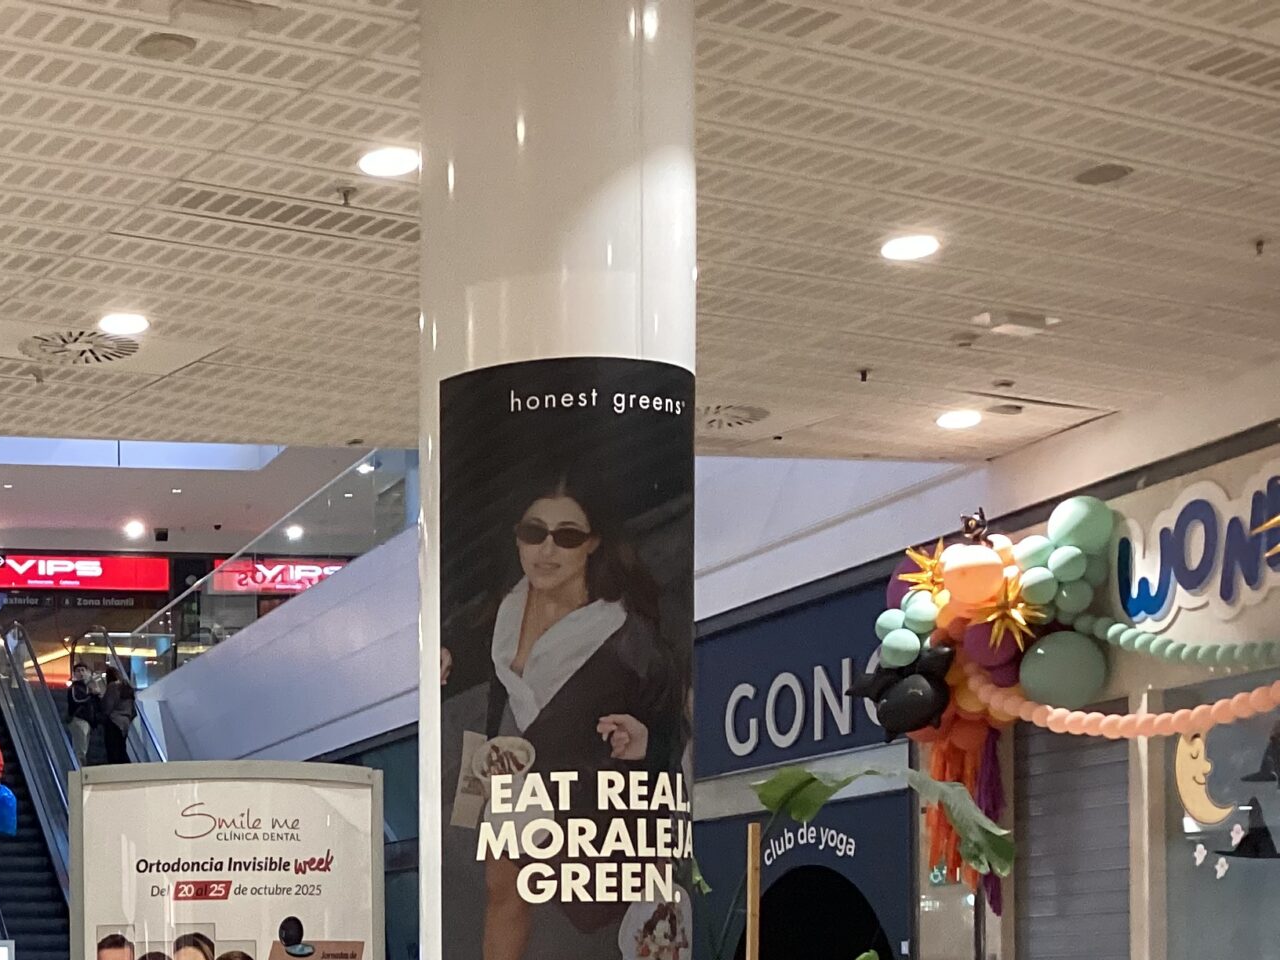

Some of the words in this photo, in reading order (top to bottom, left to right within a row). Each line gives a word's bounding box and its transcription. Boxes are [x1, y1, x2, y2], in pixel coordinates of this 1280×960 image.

[511, 389, 598, 412] honest
[1118, 475, 1280, 618] WON
[6, 559, 103, 577] VIPS
[77, 598, 100, 606] Zona
[490, 771, 578, 813] EAT
[175, 802, 262, 839] Smile
[271, 816, 300, 830] me
[216, 830, 259, 842] CLÍNICA
[262, 831, 301, 842] DENTAL
[476, 818, 693, 861] MORALEJA
[764, 828, 794, 866] club
[797, 820, 817, 845] de
[819, 827, 856, 857] yoga
[135, 857, 223, 873] Ortodoncia
[228, 856, 291, 872] Invisible
[294, 849, 334, 875] week
[178, 884, 195, 897] 20
[195, 883, 207, 897] al
[208, 883, 226, 897] 25
[233, 883, 248, 897] de
[250, 884, 293, 897] octubre
[294, 884, 322, 896] 2025
[516, 862, 681, 904] GREEN.
[349, 951, 358, 960] de
